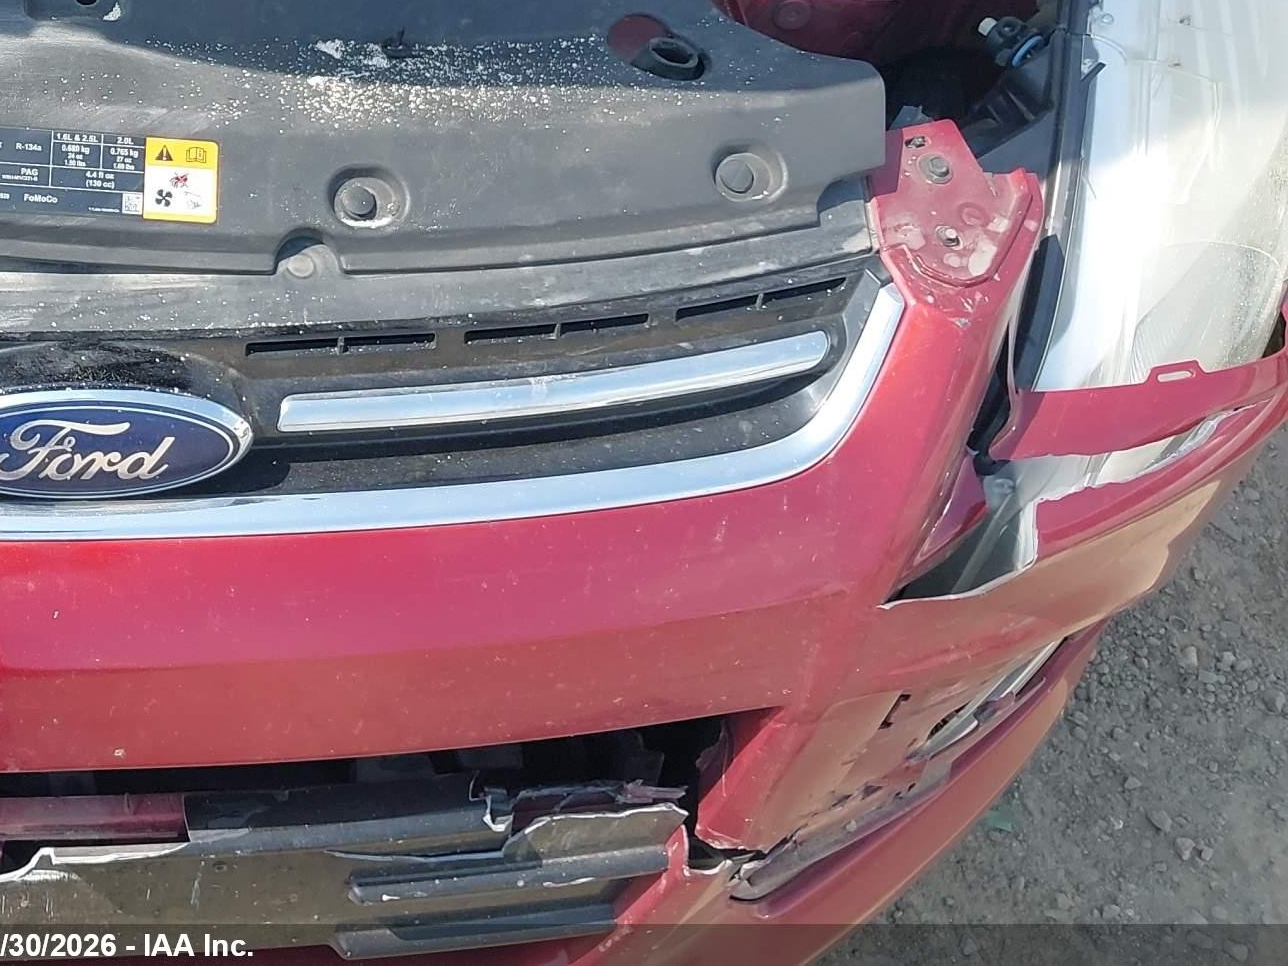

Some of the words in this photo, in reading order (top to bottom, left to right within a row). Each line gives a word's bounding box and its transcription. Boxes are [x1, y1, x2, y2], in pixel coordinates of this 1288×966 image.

[16, 142, 42, 152] R-134a
[81, 146, 90, 154] kg
[130, 149, 139, 158] kg
[20, 168, 38, 176] PAG
[86, 180, 102, 188] (130
[103, 181, 115, 189] cc)
[23, 193, 58, 204] FoMoCo
